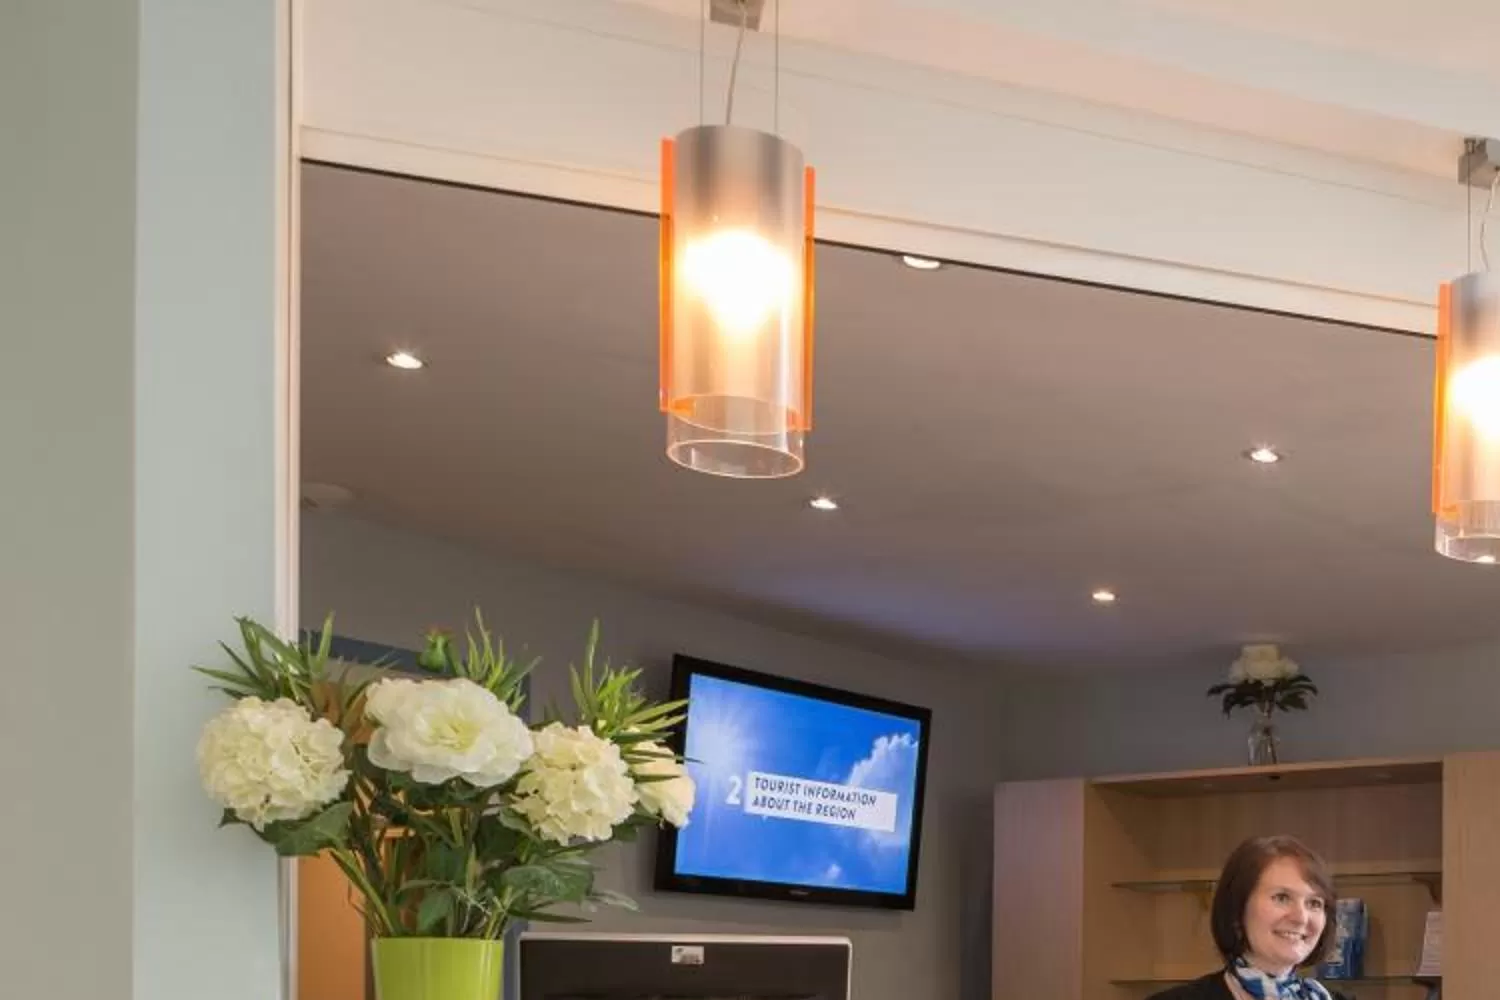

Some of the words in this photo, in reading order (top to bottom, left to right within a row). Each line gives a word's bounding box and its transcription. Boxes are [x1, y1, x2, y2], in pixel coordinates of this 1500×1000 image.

[726, 775, 741, 805] 2
[754, 776, 801, 797] TOURIST
[803, 783, 877, 806] INFORMATION
[751, 795, 791, 811] ABOUT
[793, 800, 813, 815] THE
[815, 803, 857, 821] REGION
